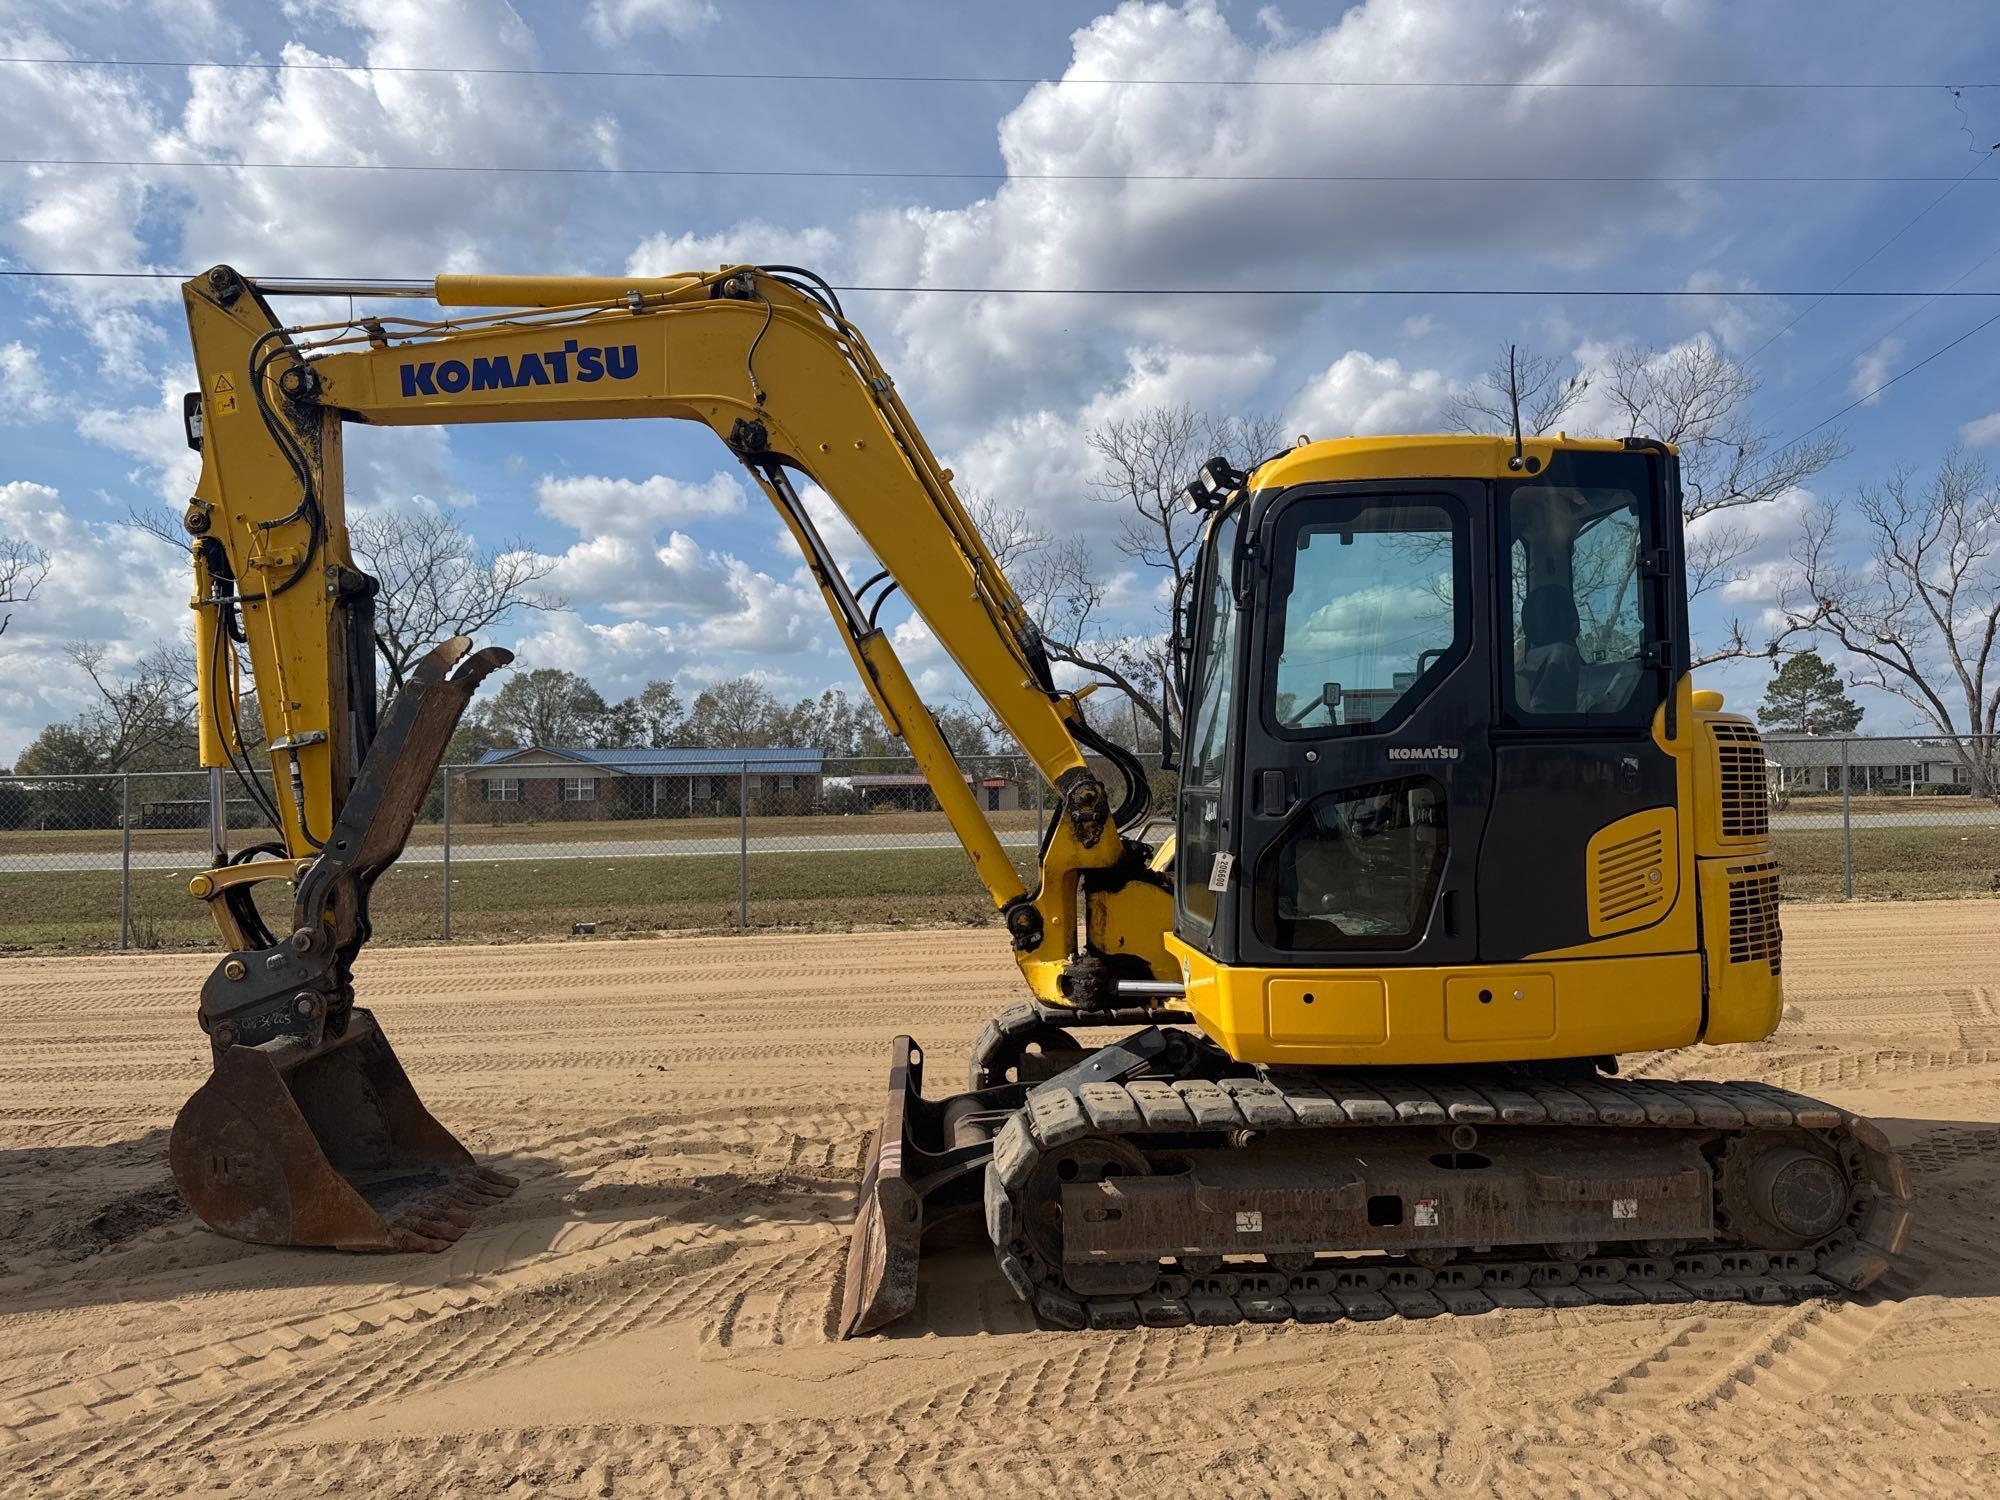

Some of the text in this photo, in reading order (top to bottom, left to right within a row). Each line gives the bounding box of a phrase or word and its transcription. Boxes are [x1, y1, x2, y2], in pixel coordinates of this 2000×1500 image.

[399, 339, 639, 398] KOMATSU
[1388, 745, 1459, 760] KOMATSU
[1215, 861, 1229, 887] 206600
